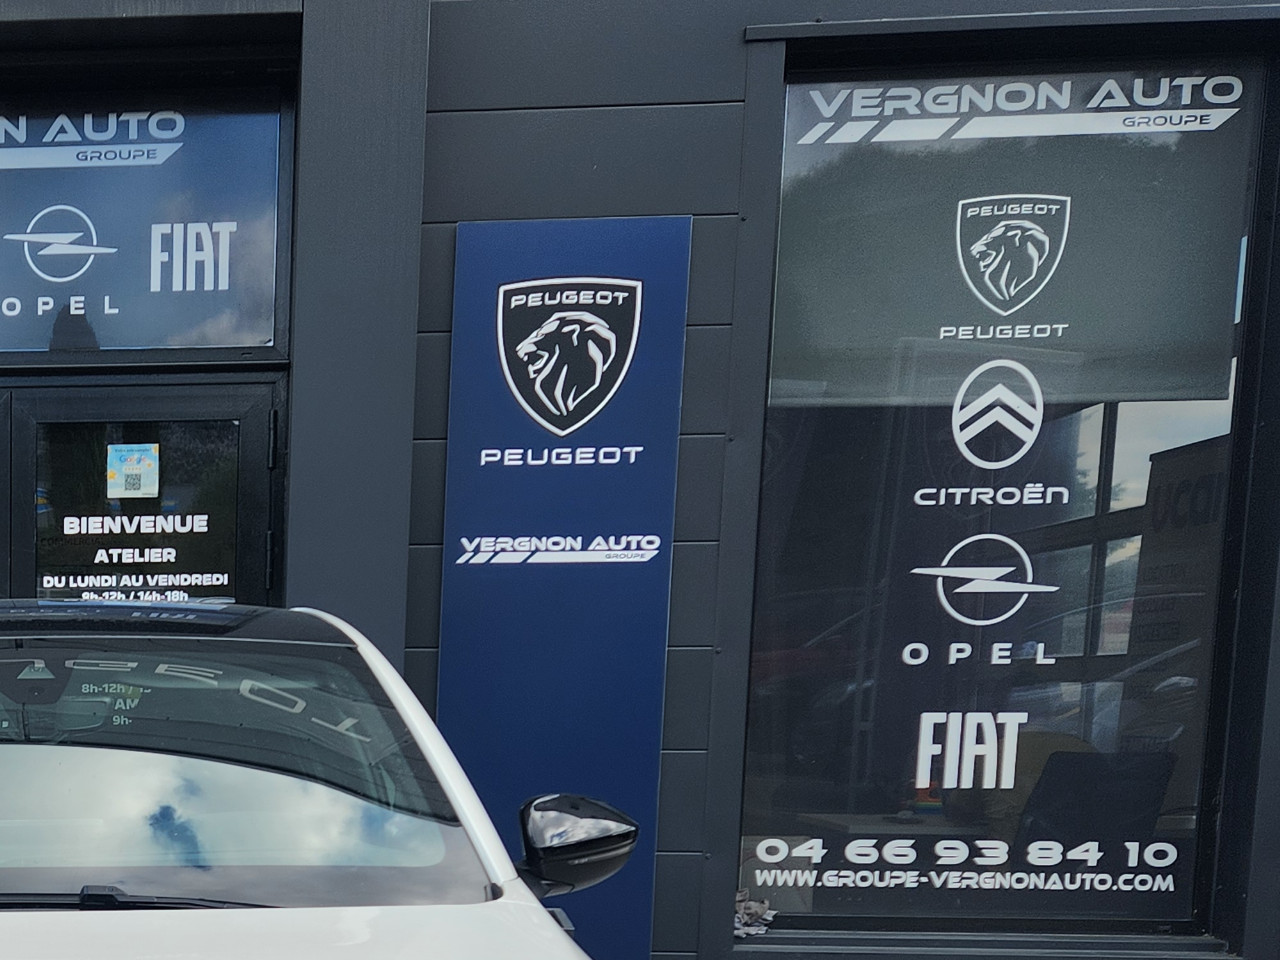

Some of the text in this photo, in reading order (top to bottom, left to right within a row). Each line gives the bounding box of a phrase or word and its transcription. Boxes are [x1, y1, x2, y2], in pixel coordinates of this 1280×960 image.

[809, 75, 1244, 119] VERGNON AUTO
[42, 111, 186, 142] AUTO
[1122, 113, 1212, 127] GROUPE
[75, 148, 158, 162] GROUPE
[966, 203, 1061, 218] PEUGEOT
[150, 221, 238, 292] FIAT
[1, 295, 120, 317] OPEL
[510, 290, 629, 309] PEUGEOT
[939, 323, 1069, 340] PEUGEOT
[480, 446, 644, 466] PEUGEOT
[63, 514, 209, 535] BIENVENUE
[460, 535, 662, 552] VERGNON AUTO
[93, 547, 177, 564] ATELIER
[604, 551, 646, 560] GROUPE
[42, 573, 229, 588] DU LUNDI AU VENDREDI
[902, 643, 1057, 666] OPEL
[81, 683, 126, 694] 8h-12h
[915, 711, 1029, 790] FIAT
[755, 838, 1178, 868] 04 66 93 84 10
[754, 869, 1176, 893] WWW.GROUPE-VERGNONAUTO.COM
